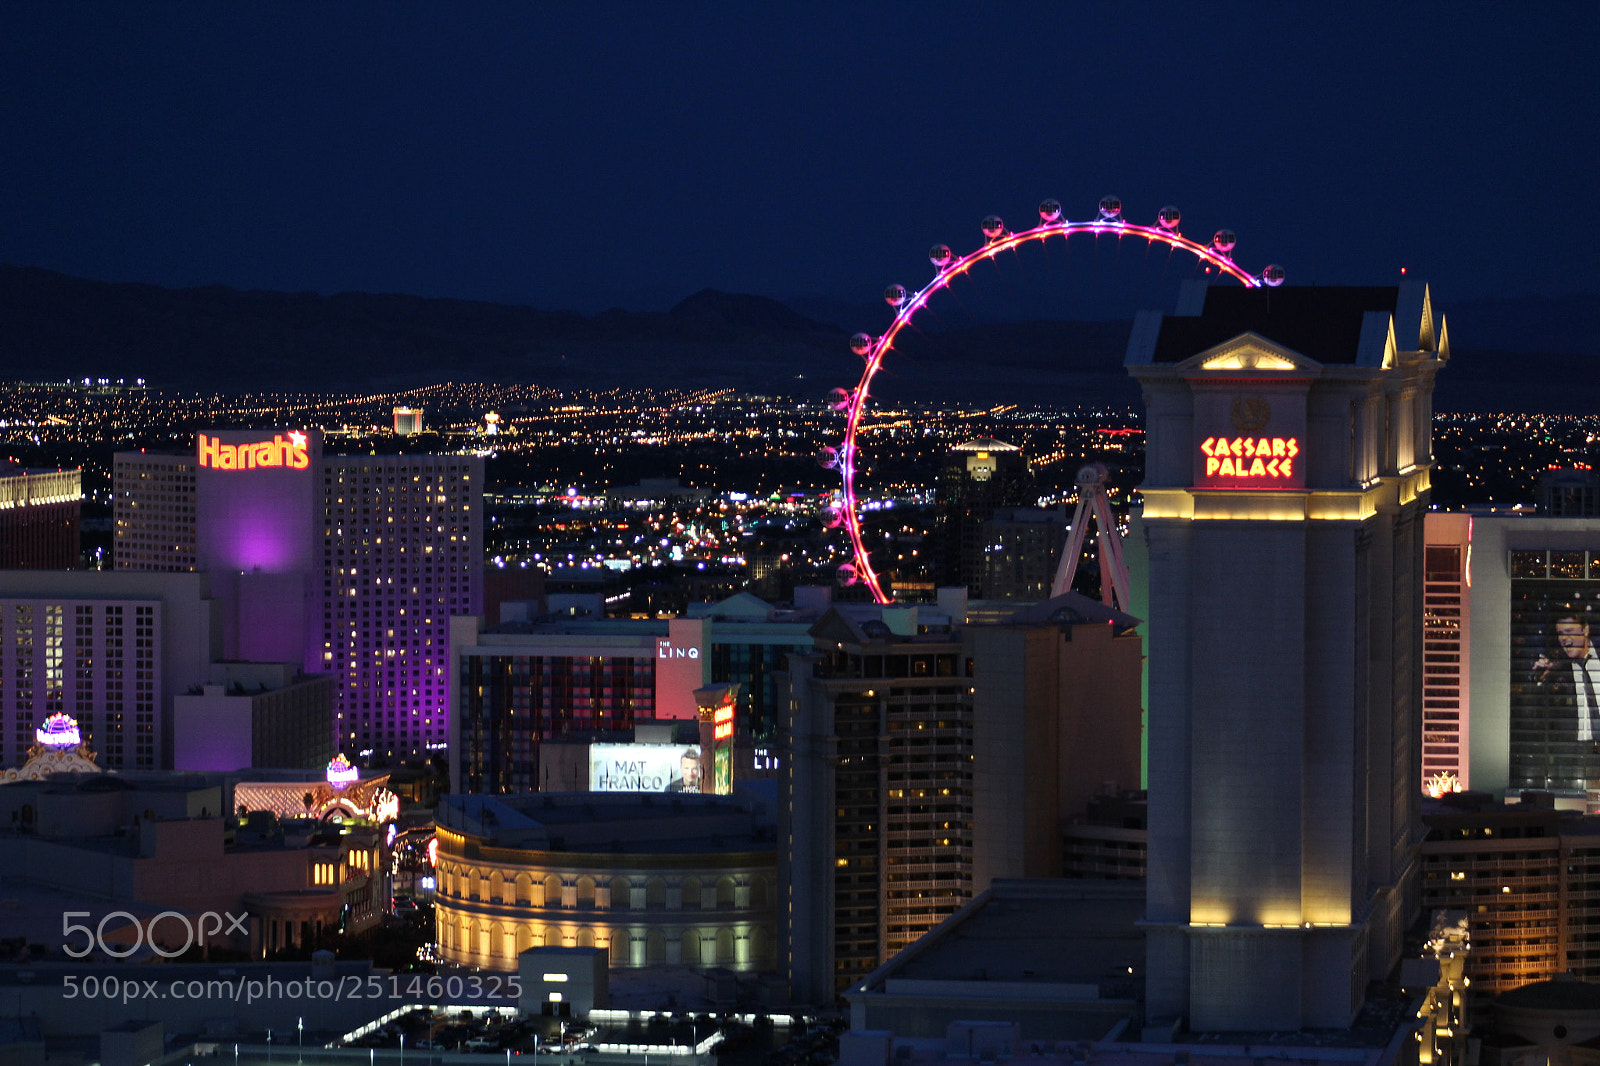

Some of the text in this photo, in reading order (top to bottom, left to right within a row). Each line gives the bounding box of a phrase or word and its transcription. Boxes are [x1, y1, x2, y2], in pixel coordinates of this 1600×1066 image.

[1200, 436, 1299, 458] CAESARS
[1206, 456, 1293, 478] PALACE
[659, 647, 699, 659] LINQ
[754, 748, 768, 756] THE
[615, 760, 647, 775] MAT
[599, 775, 663, 790] FRANCO
